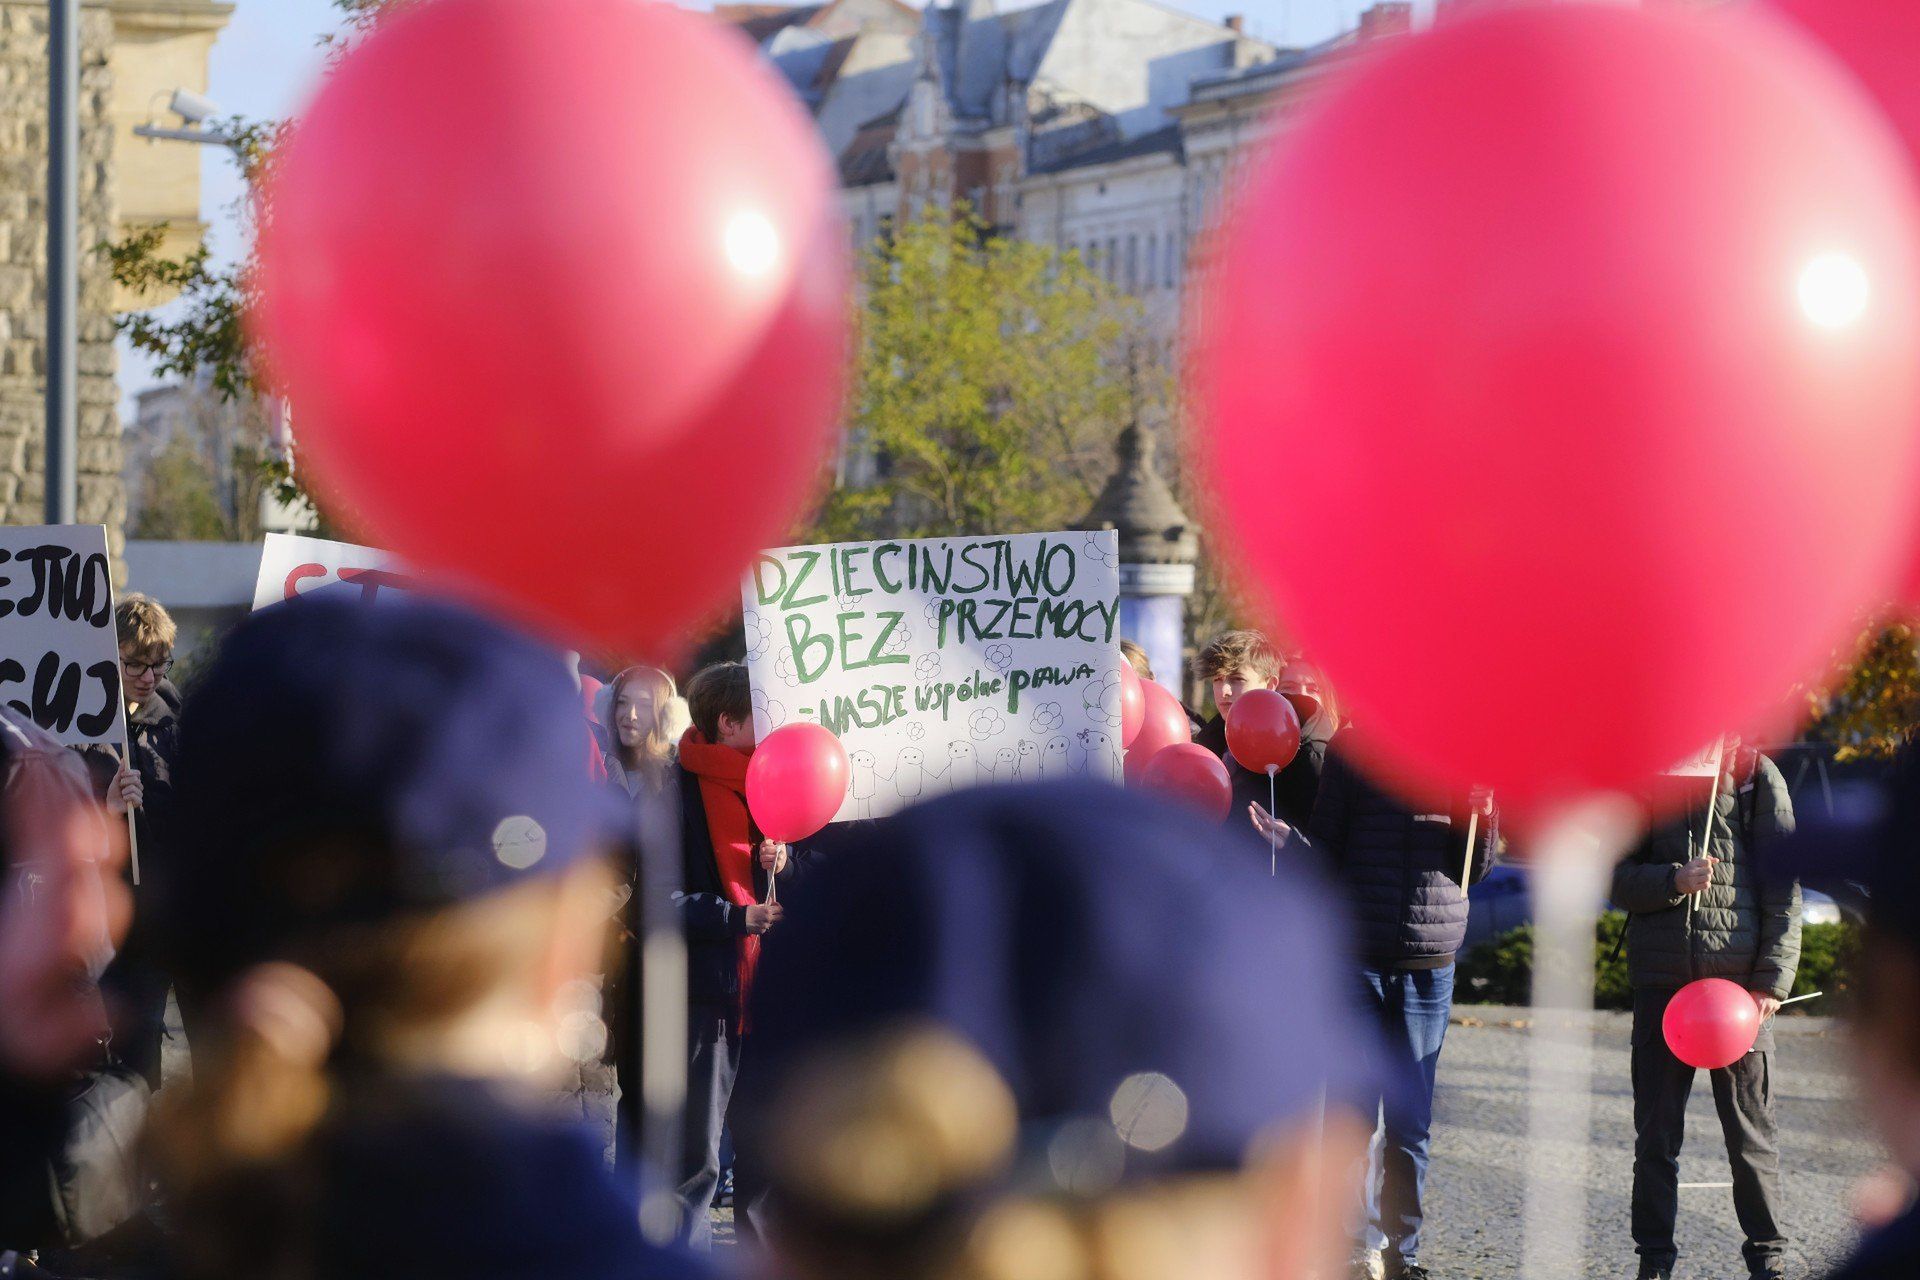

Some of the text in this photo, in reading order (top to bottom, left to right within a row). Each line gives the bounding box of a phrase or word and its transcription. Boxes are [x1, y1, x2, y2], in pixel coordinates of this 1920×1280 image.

[753, 537, 1075, 611] DZIECIŃSTWO
[785, 595, 1120, 684] BEZ PRZEMOCY
